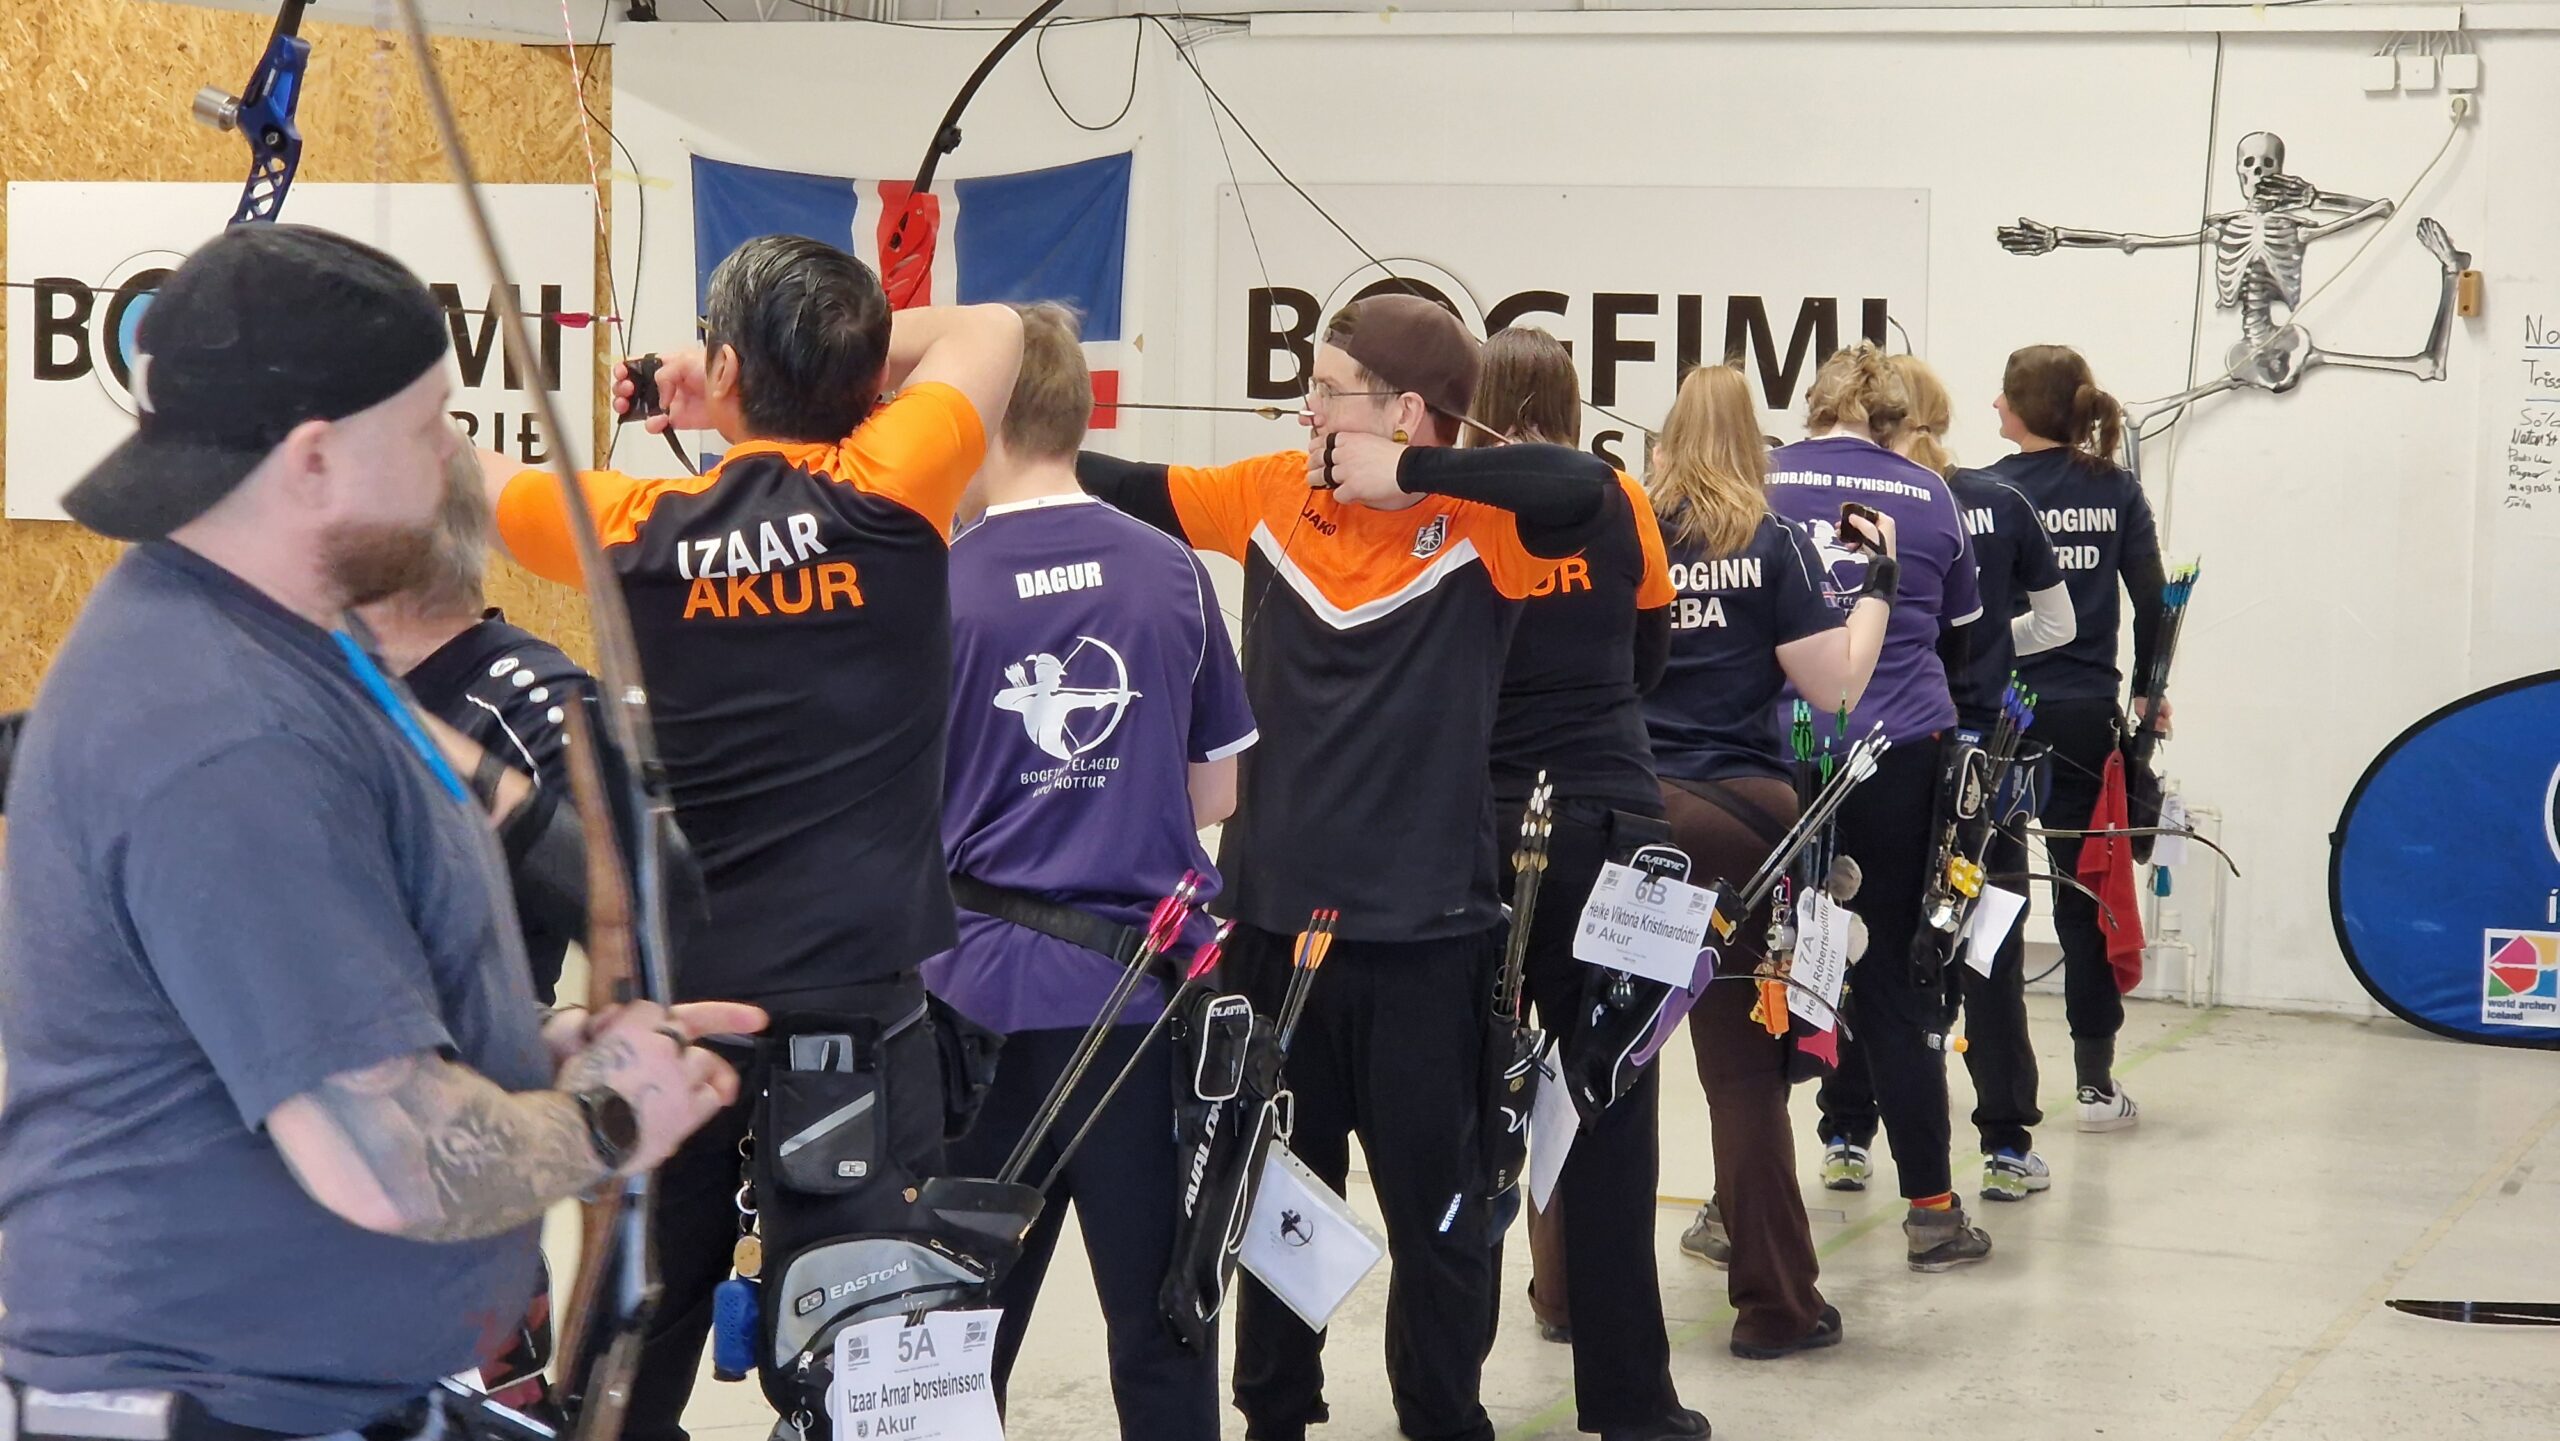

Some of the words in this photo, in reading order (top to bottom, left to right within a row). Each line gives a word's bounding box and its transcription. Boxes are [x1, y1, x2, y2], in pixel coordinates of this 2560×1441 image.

[1836, 475, 1932, 501] REYNISDÓTTIR
[1301, 508, 1337, 536] JAKO
[678, 513, 828, 580] IZAAR
[1015, 561, 1103, 599] DAGUR
[1668, 557, 1762, 591] OGINN
[683, 561, 864, 619] AKUR
[1670, 597, 1727, 629] EBA
[1635, 880, 1668, 906] 6B
[1586, 901, 1610, 921] Heike
[1598, 926, 1632, 946] Akur
[1799, 936, 1815, 965] 7A
[1805, 984, 1819, 1016] Hea
[2487, 1010, 2523, 1020] iceland
[2488, 1000, 2516, 1009] world
[2519, 1000, 2557, 1012] archery
[830, 1259, 909, 1300] EASTON
[898, 1328, 936, 1363] 5A
[848, 1389, 877, 1414] Izaar
[881, 1384, 911, 1408] Arnar
[913, 1372, 985, 1402] Þorsteinsson
[875, 1415, 917, 1437] Akur
